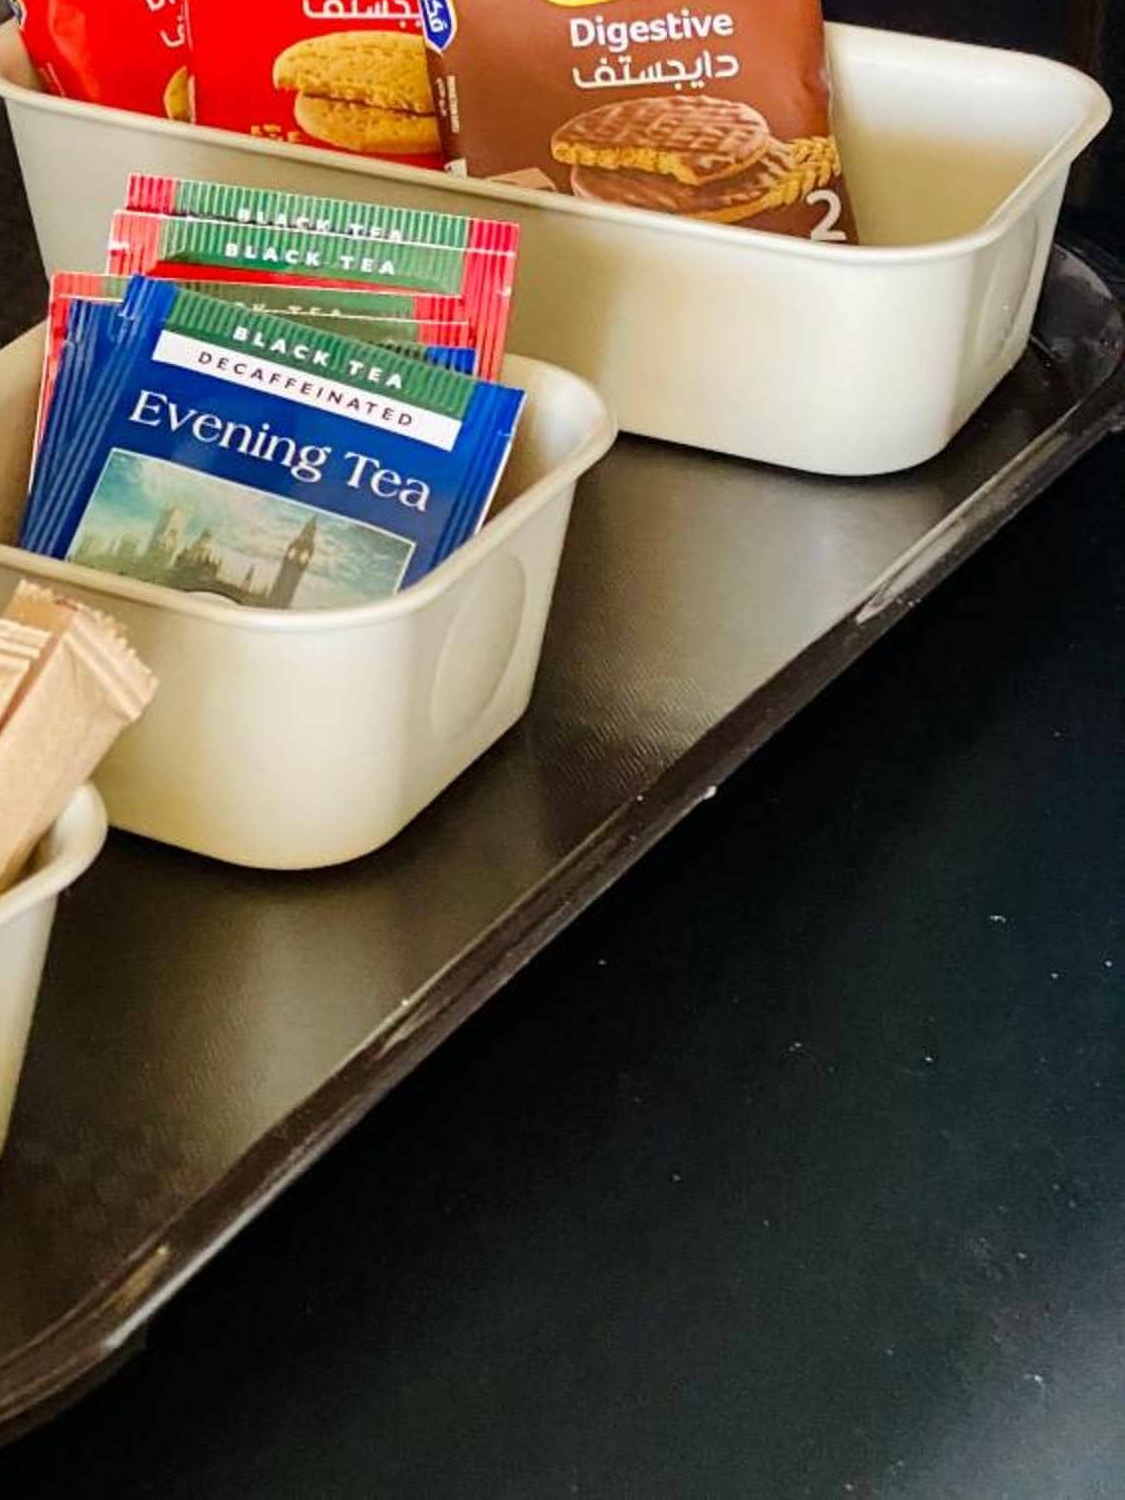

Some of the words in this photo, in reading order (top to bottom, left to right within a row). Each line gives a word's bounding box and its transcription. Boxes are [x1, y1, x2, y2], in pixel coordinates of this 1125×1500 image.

[570, 8, 735, 53] Digestive
[572, 50, 741, 90] دايجستف
[806, 189, 848, 242] 2
[225, 243, 321, 268] BLACK
[339, 255, 396, 276] TEA
[232, 326, 331, 368] BLACK
[347, 359, 405, 390] TEA
[197, 351, 414, 428] DECAFFEINATED
[128, 388, 332, 484] Evening
[344, 451, 432, 513] Tea
